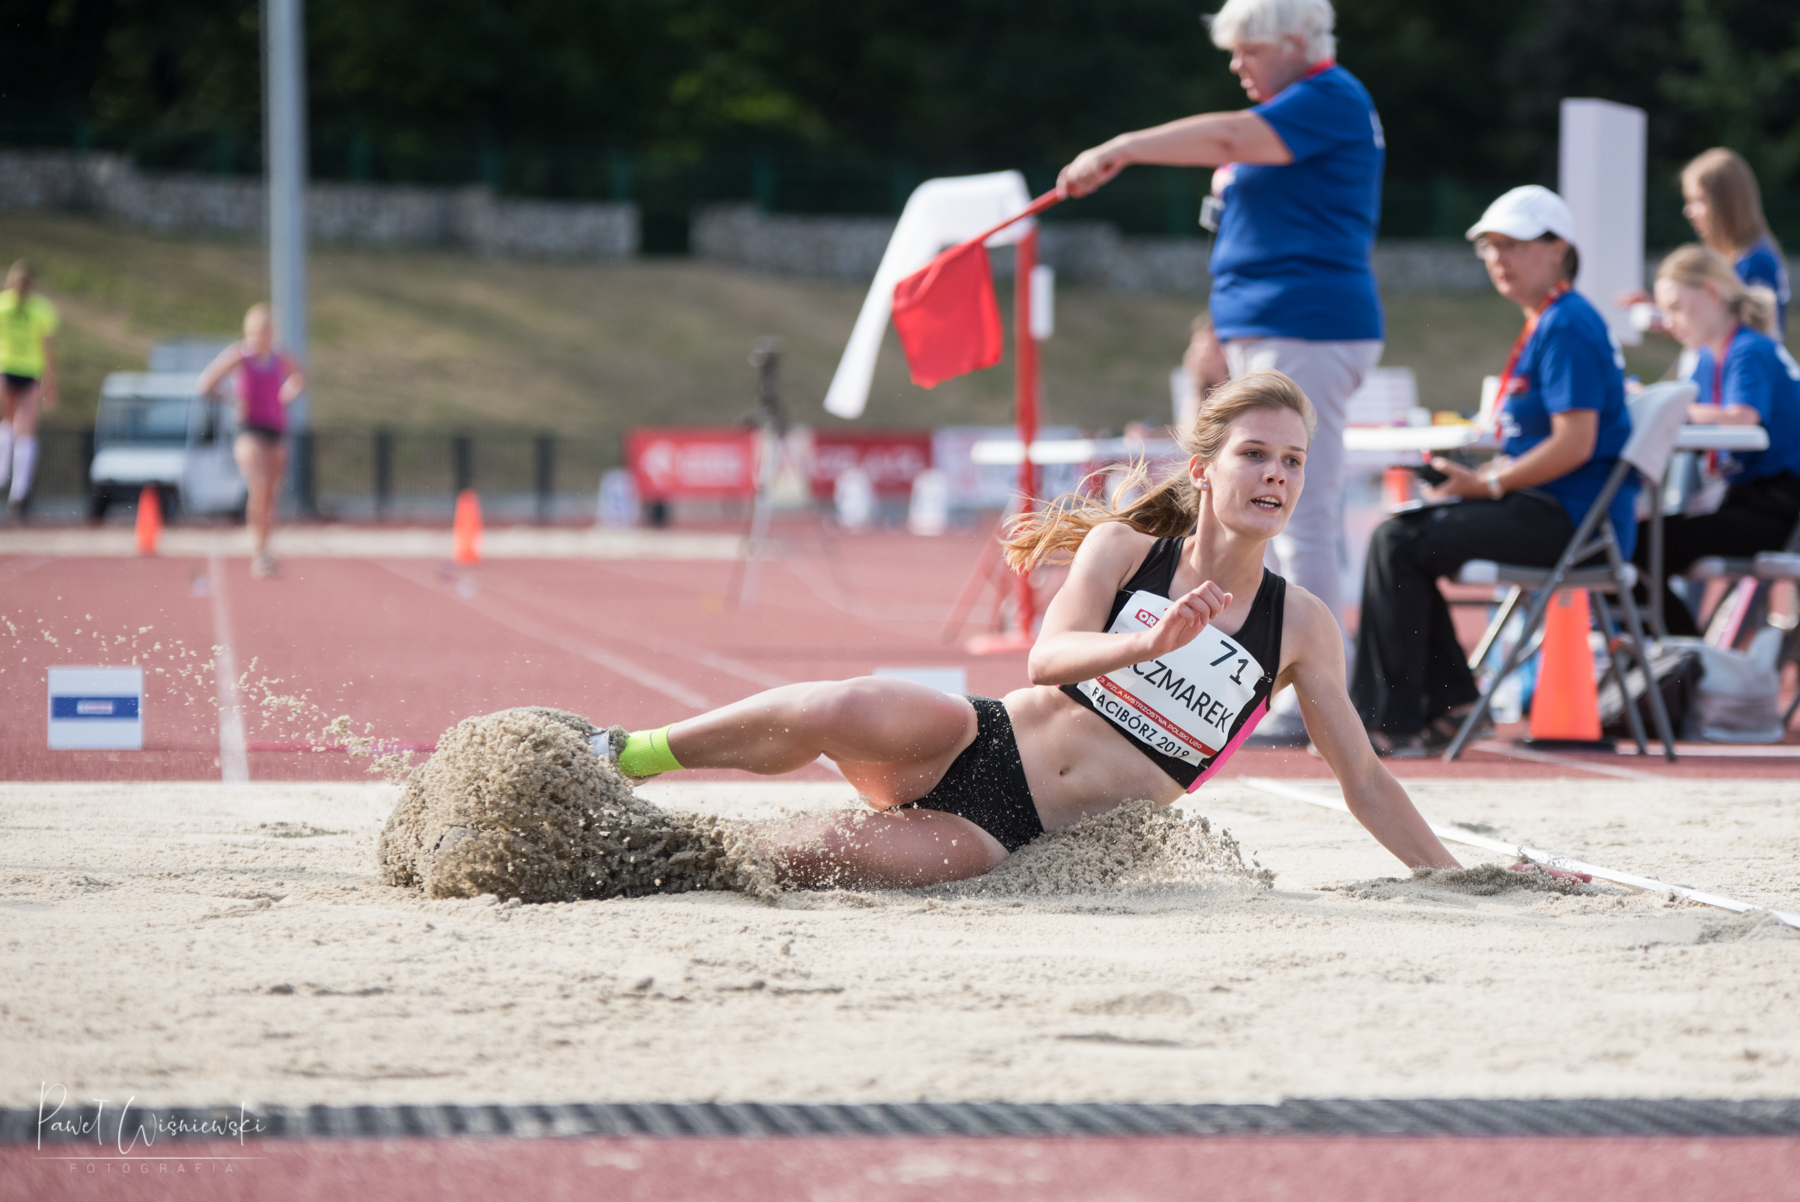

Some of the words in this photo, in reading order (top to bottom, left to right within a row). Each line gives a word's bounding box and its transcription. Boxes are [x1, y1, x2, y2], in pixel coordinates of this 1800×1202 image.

[1138, 611, 1157, 627] OR
[1209, 639, 1249, 686] 71
[1105, 682, 1123, 697] PZLA
[1122, 693, 1167, 727] MISTRZOSTWA
[1166, 723, 1190, 742] POLSKI
[1188, 738, 1203, 750] U20
[1126, 658, 1235, 734] CZMAREK
[1155, 736, 1190, 758] 2019
